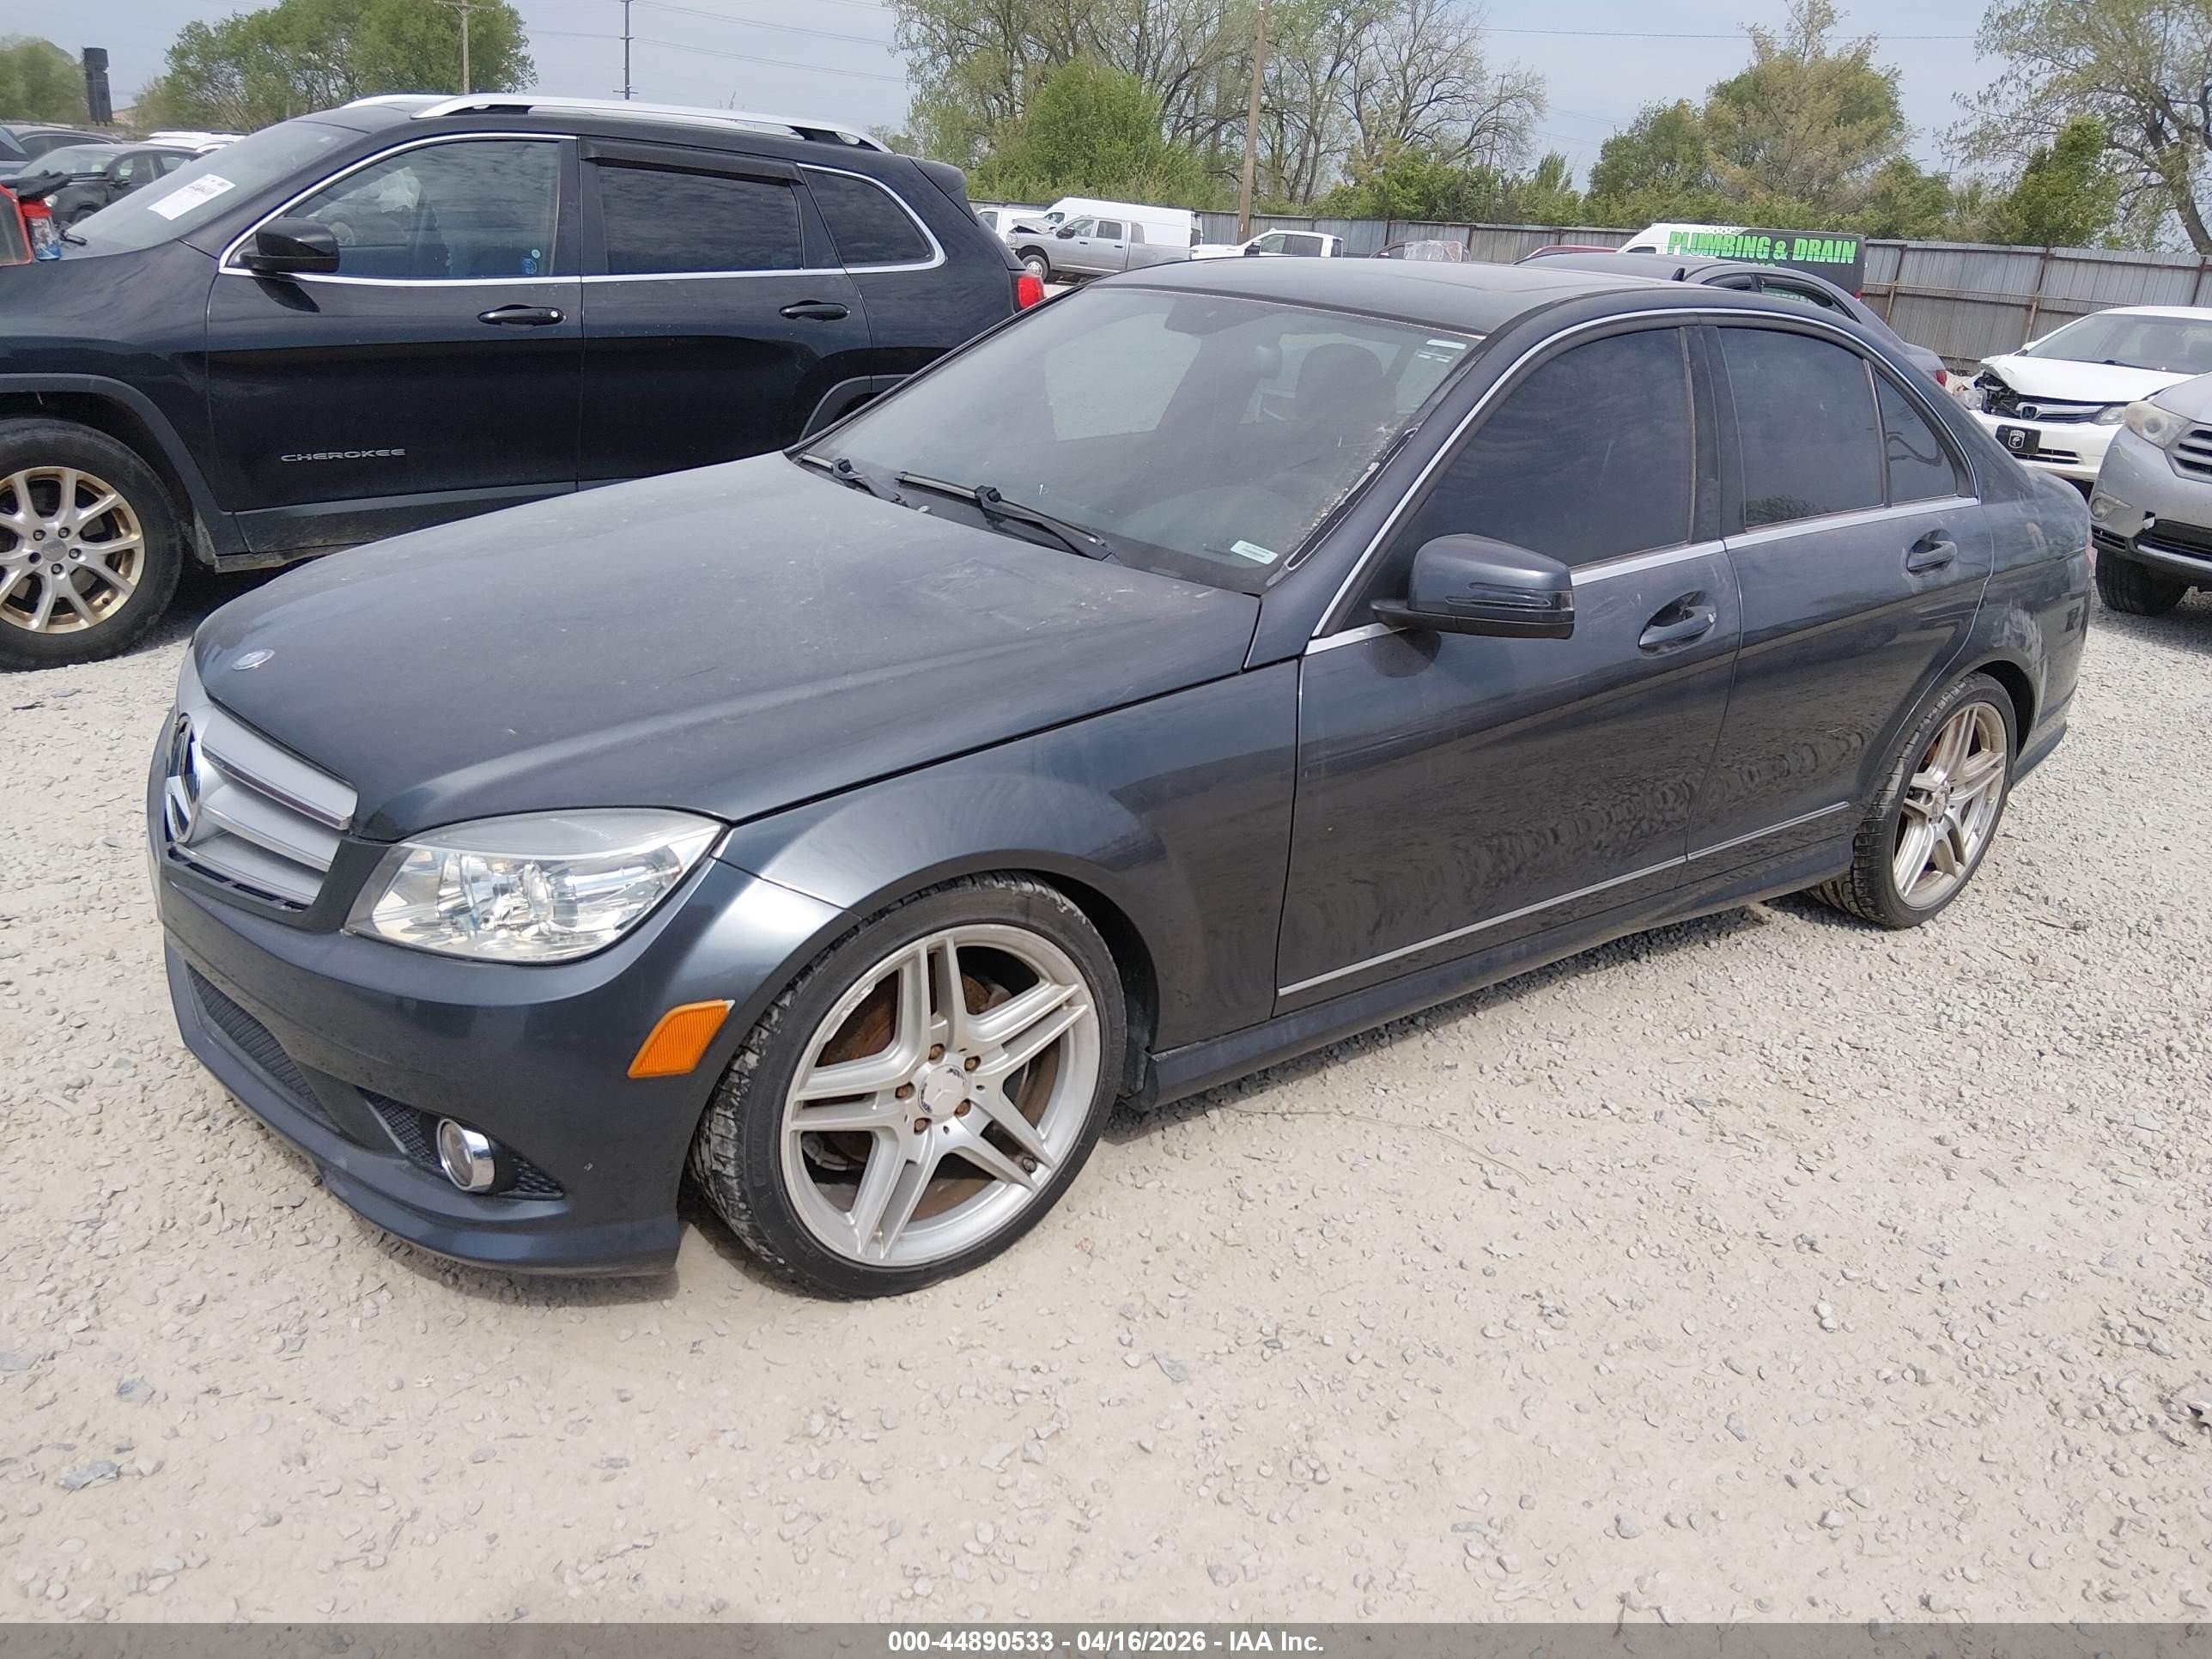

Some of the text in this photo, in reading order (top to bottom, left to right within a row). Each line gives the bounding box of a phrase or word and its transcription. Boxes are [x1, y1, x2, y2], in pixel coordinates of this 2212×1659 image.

[1667, 230, 1857, 264] PLUMBING & DRAIN
[281, 448, 406, 462] CHEROKEE
